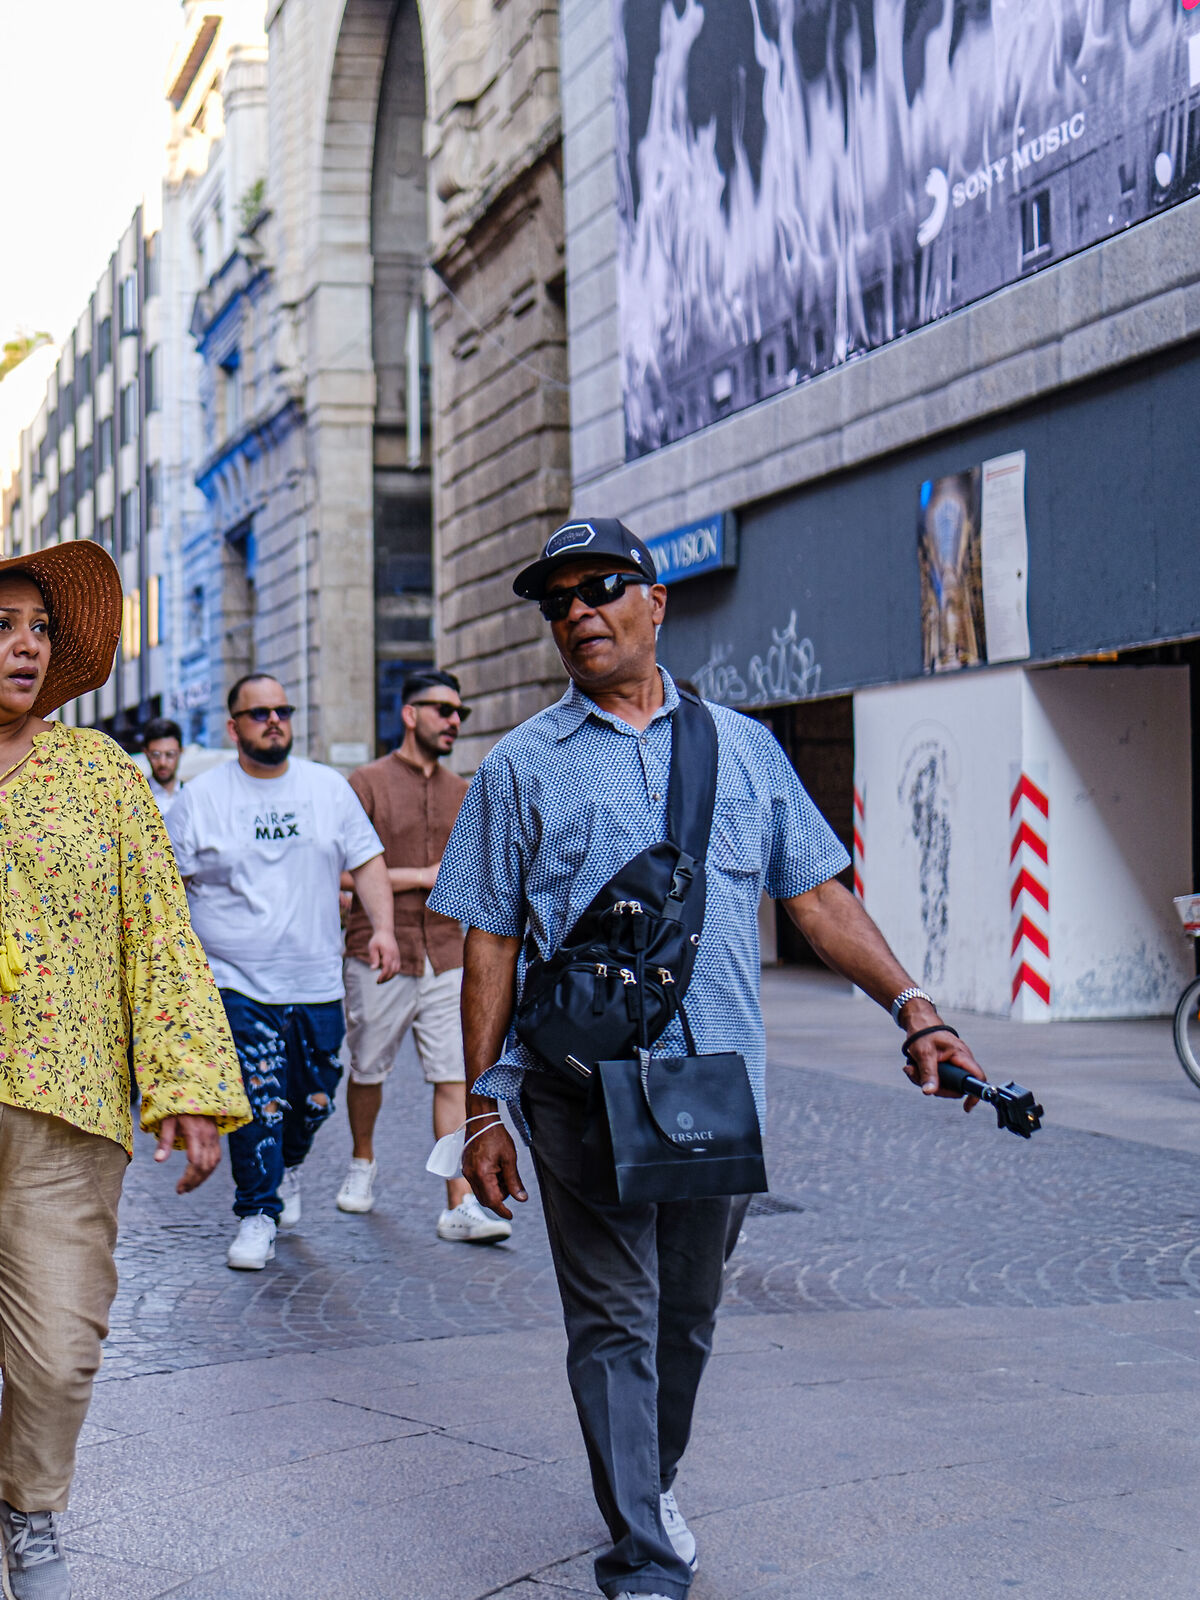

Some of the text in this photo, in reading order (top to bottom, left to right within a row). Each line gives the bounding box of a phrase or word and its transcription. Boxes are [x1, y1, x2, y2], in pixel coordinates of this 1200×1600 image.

[952, 112, 1085, 208] SONY MUSIC
[670, 524, 718, 569] VISION
[254, 812, 279, 825] AIR
[256, 824, 300, 840] MAX
